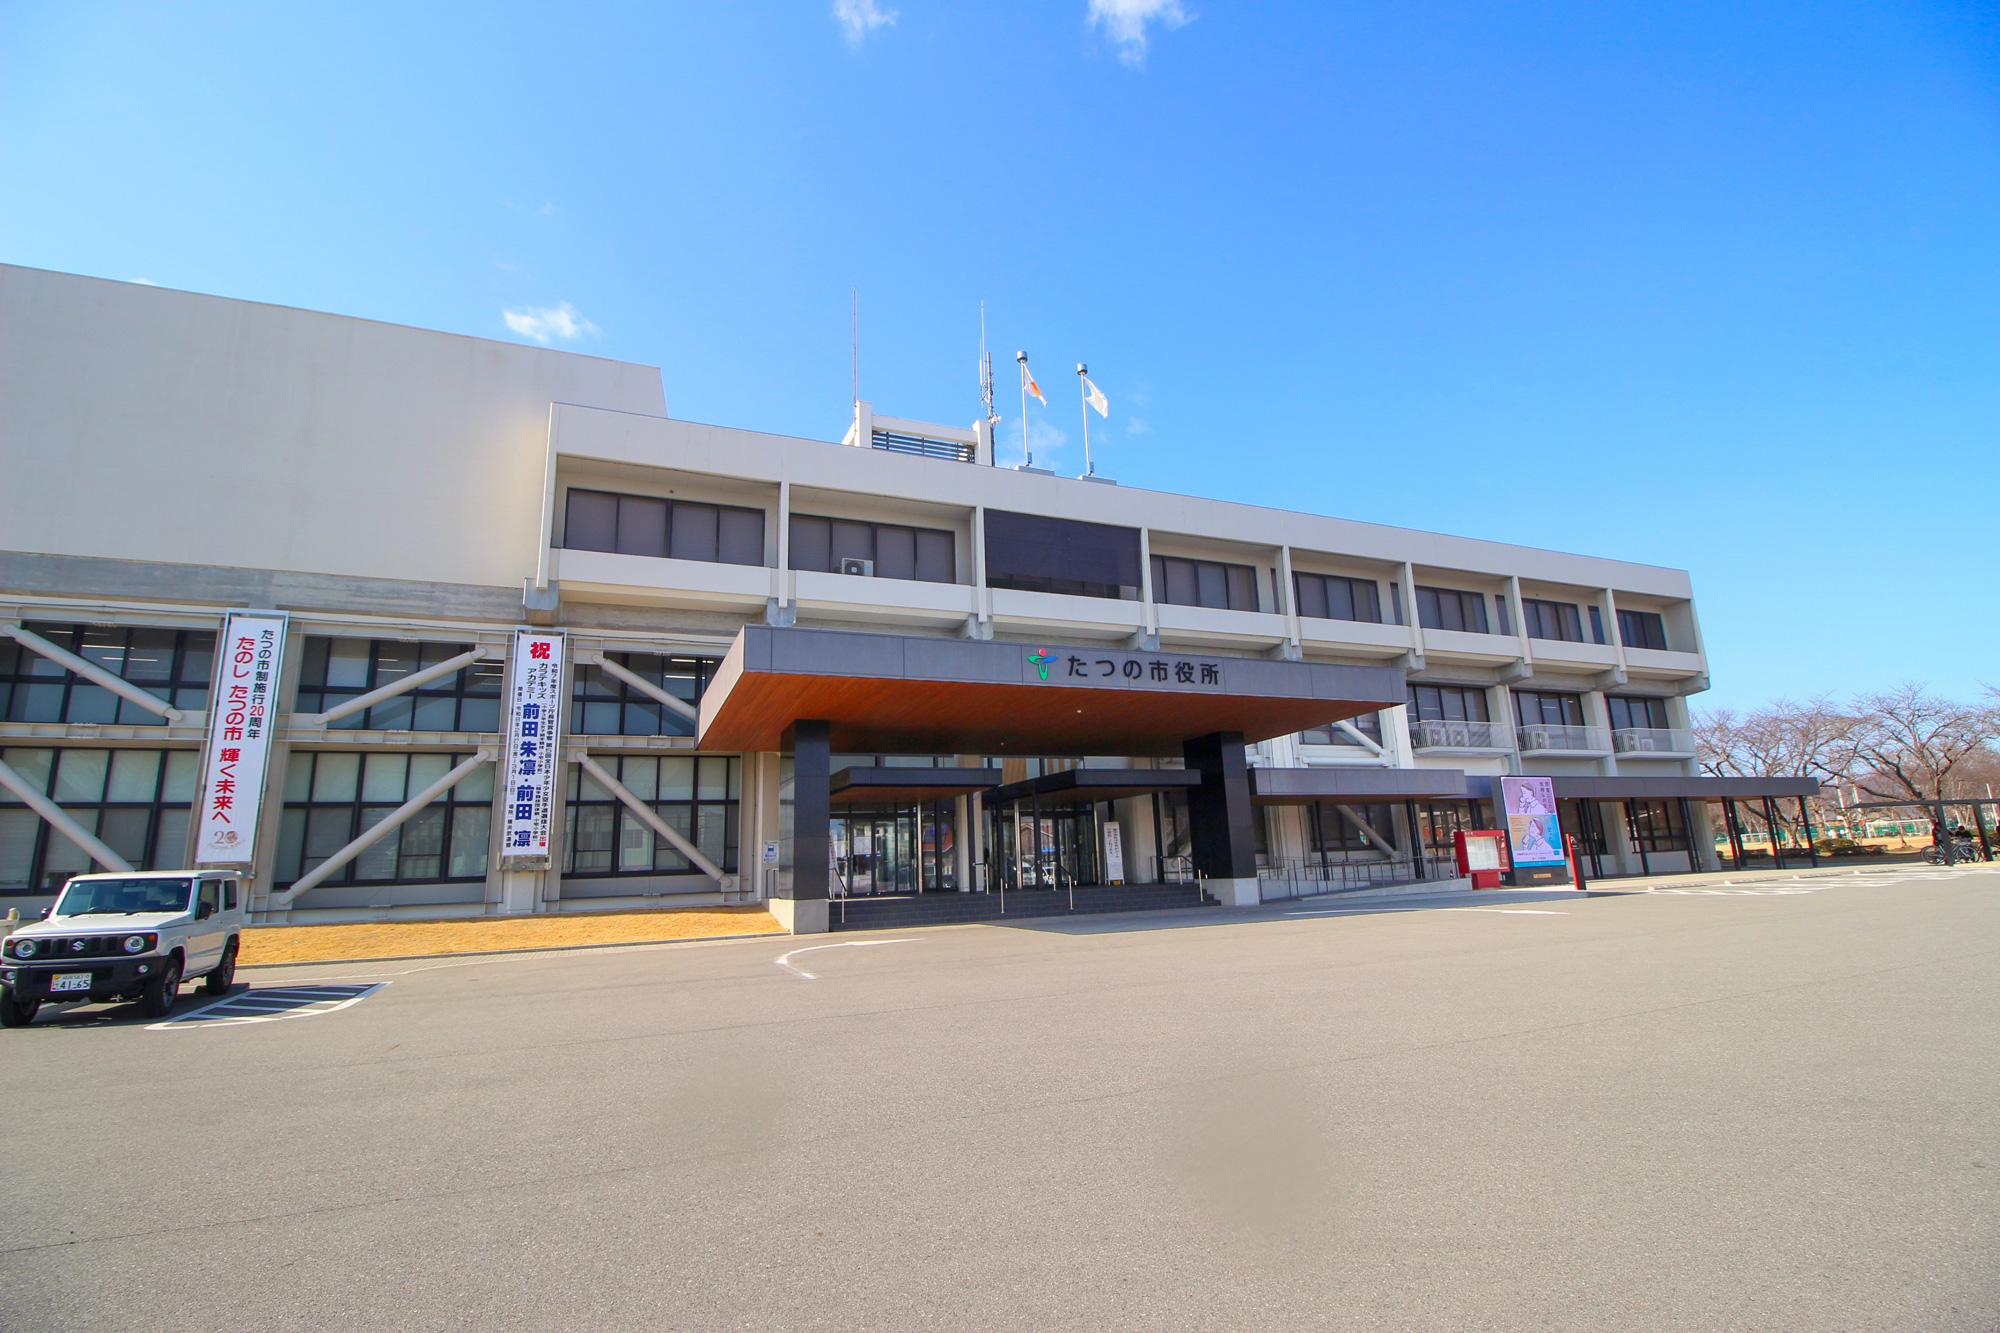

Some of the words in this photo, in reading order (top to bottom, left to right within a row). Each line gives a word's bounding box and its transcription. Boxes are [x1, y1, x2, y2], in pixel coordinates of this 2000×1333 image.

[232, 636, 255, 678] たのし
[530, 642, 550, 660] 祝
[1068, 655, 1220, 685] たつの市役所
[247, 629, 274, 740] たつの市制施行20周年
[526, 668, 536, 699] アカデミー
[537, 662, 548, 699] カラテキッズ
[224, 684, 248, 740] たつの市
[212, 748, 241, 824] 輝く未来へ
